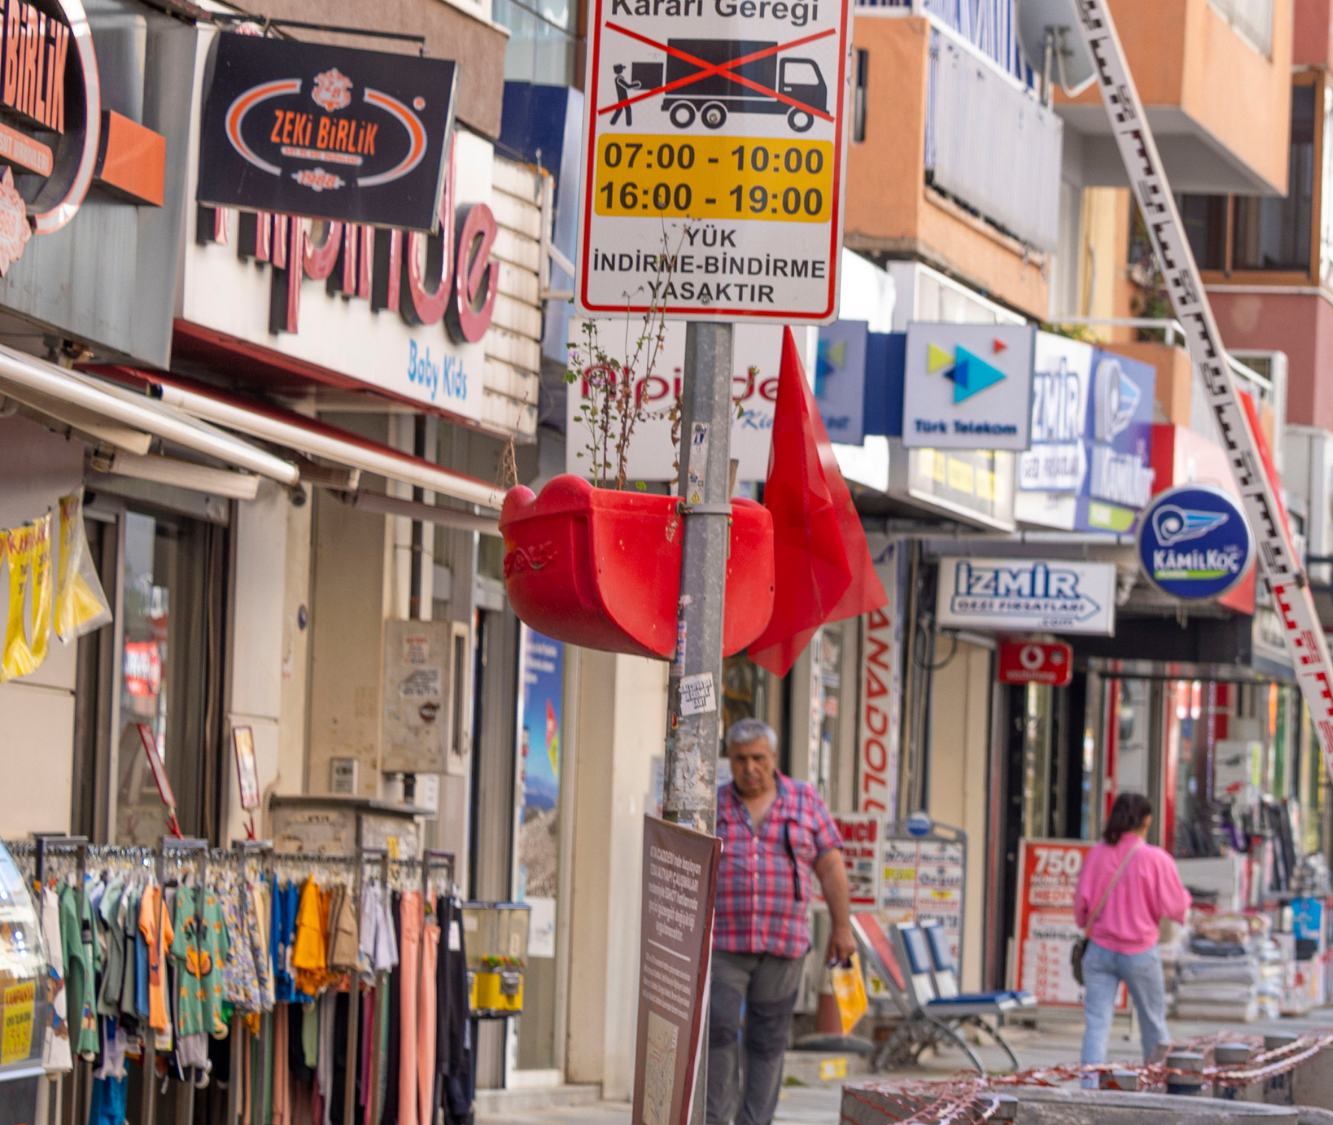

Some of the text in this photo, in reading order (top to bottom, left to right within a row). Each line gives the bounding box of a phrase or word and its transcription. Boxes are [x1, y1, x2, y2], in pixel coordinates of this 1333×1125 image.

[271, 110, 313, 147] ZEKİ
[317, 116, 378, 156] BİRLİK
[604, 142, 695, 170] 07:00
[731, 145, 824, 175] 10:00
[600, 181, 692, 211] 16:00
[729, 185, 823, 216] 19:00
[687, 224, 737, 248] YÜK
[593, 249, 826, 279] İNDİRME-BİNDİRME
[647, 281, 775, 303] YASAKTIR
[408, 338, 467, 400] Baby Kids
[915, 417, 1018, 435] Türk Telekom
[956, 560, 1081, 599] İZMİR
[1034, 850, 1082, 876] 750
